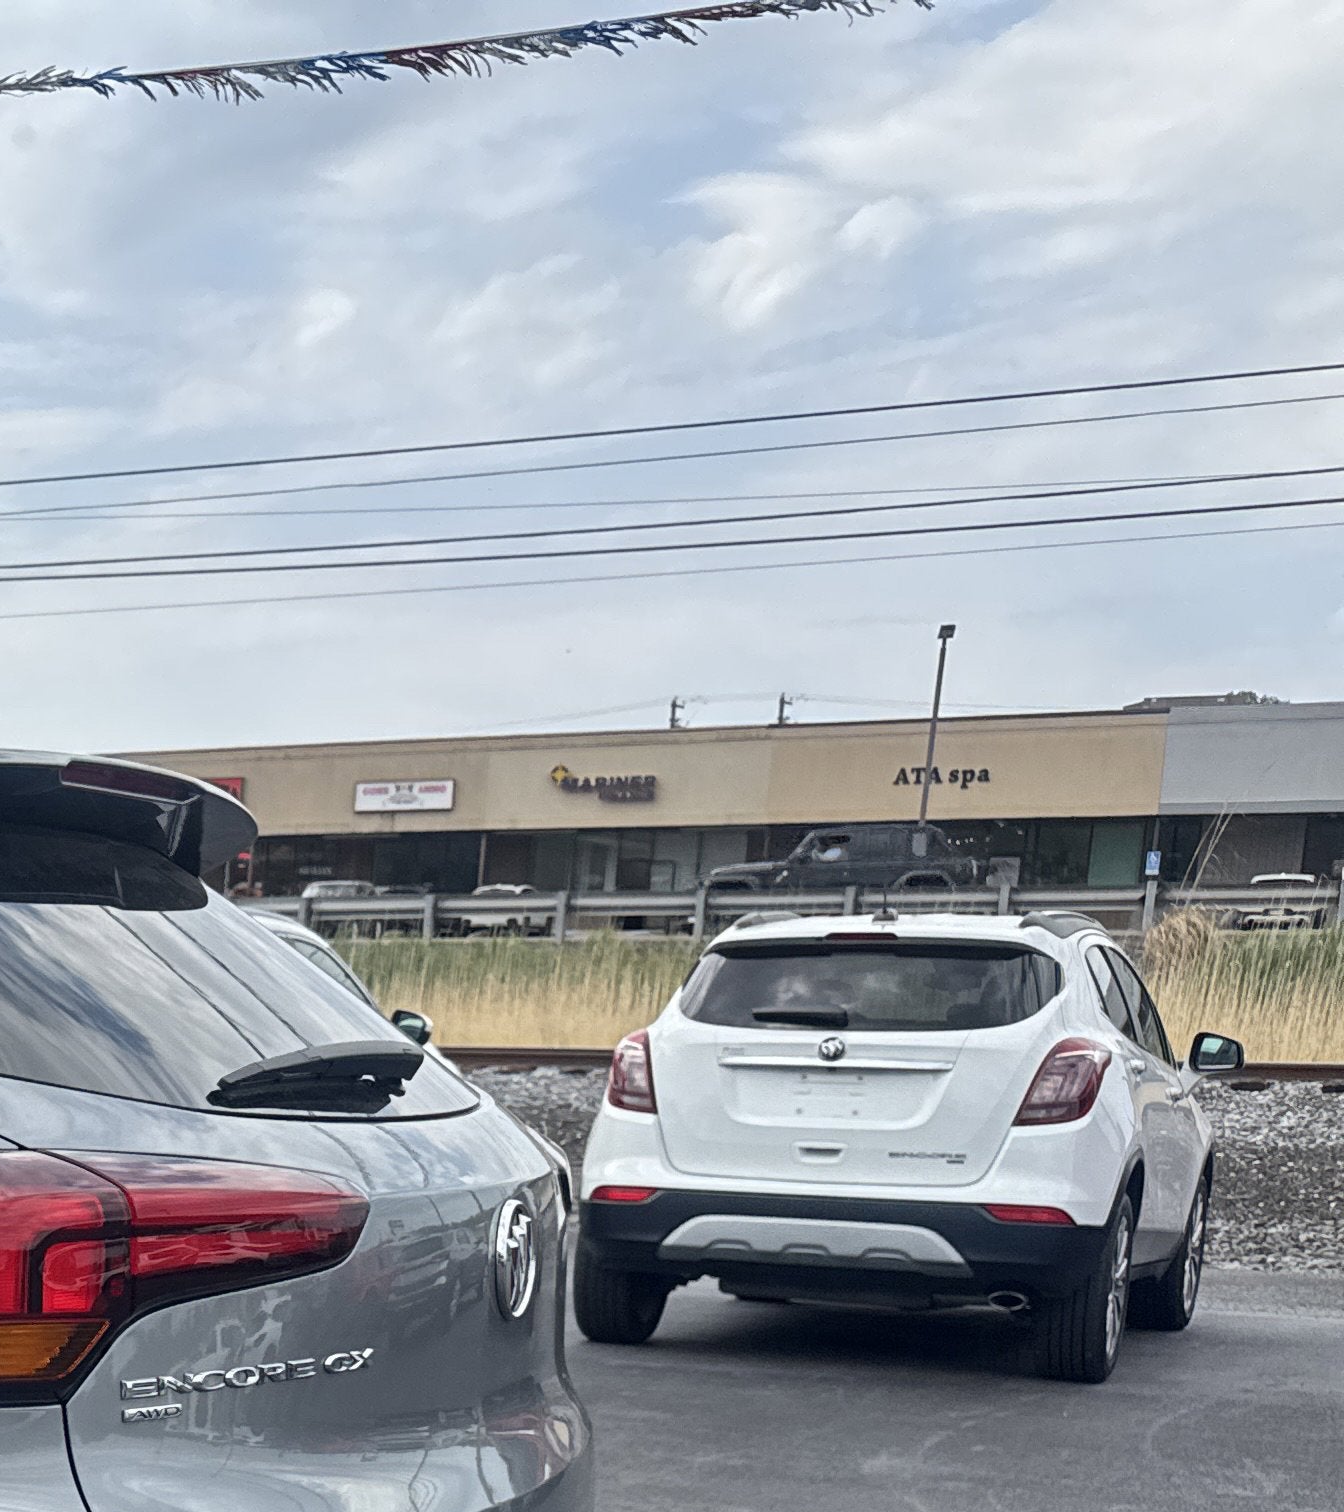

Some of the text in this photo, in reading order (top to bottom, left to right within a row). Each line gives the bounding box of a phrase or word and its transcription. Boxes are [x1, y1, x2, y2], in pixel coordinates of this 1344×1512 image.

[893, 766, 990, 790] ATA spa
[120, 1347, 375, 1400] ENCORE GX
[124, 1404, 183, 1422] AWD
